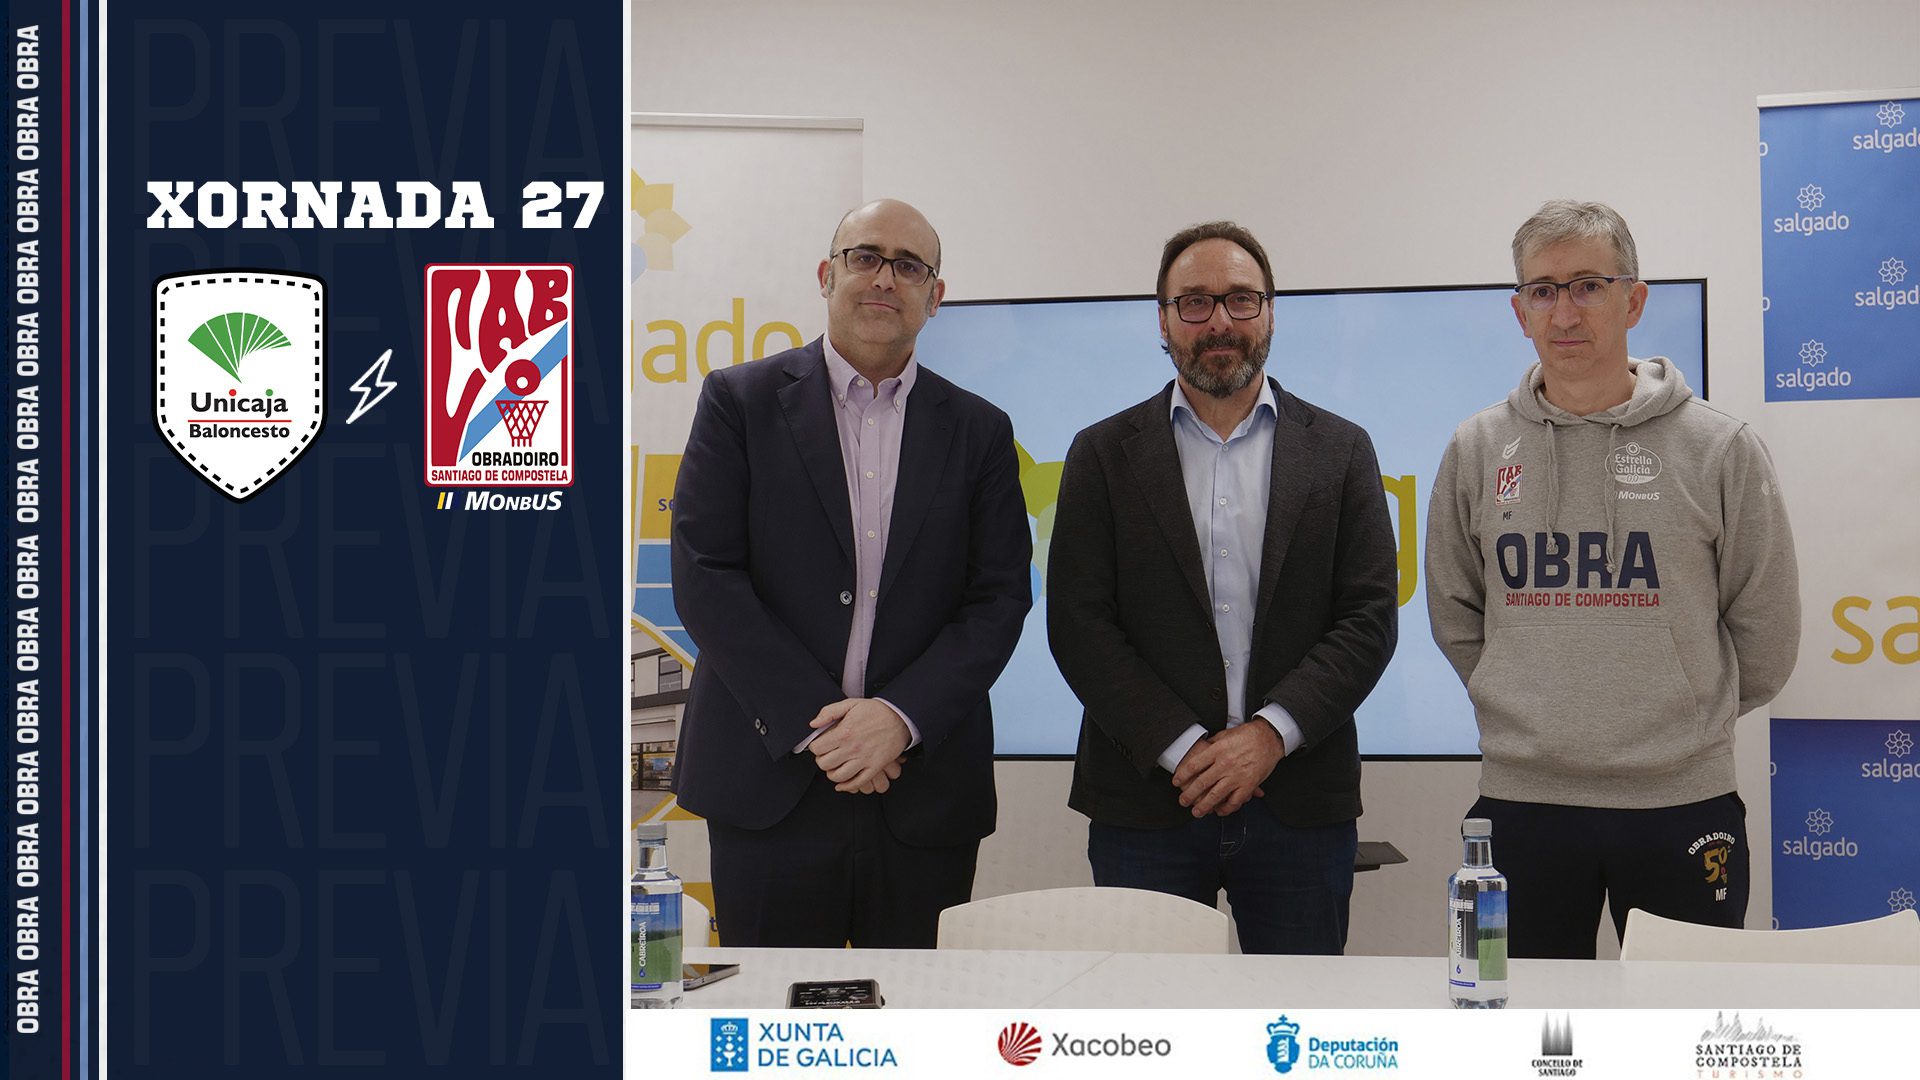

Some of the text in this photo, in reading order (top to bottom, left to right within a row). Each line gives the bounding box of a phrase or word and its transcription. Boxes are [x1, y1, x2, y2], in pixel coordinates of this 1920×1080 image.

[1774, 211, 1850, 236] salgado
[1855, 285, 1920, 310] salgad
[1776, 367, 1852, 392] salgado
[1615, 454, 1652, 465] Estrella
[1616, 464, 1650, 475] Galicia
[1503, 511, 1513, 521] MF
[1496, 532, 1660, 590] OBRA
[1506, 593, 1660, 607] SANTIAGO DE COMPOSTELA
[1688, 831, 1736, 855] OBRADOIRO
[1782, 836, 1858, 861] salgado
[1715, 888, 1727, 901] MF
